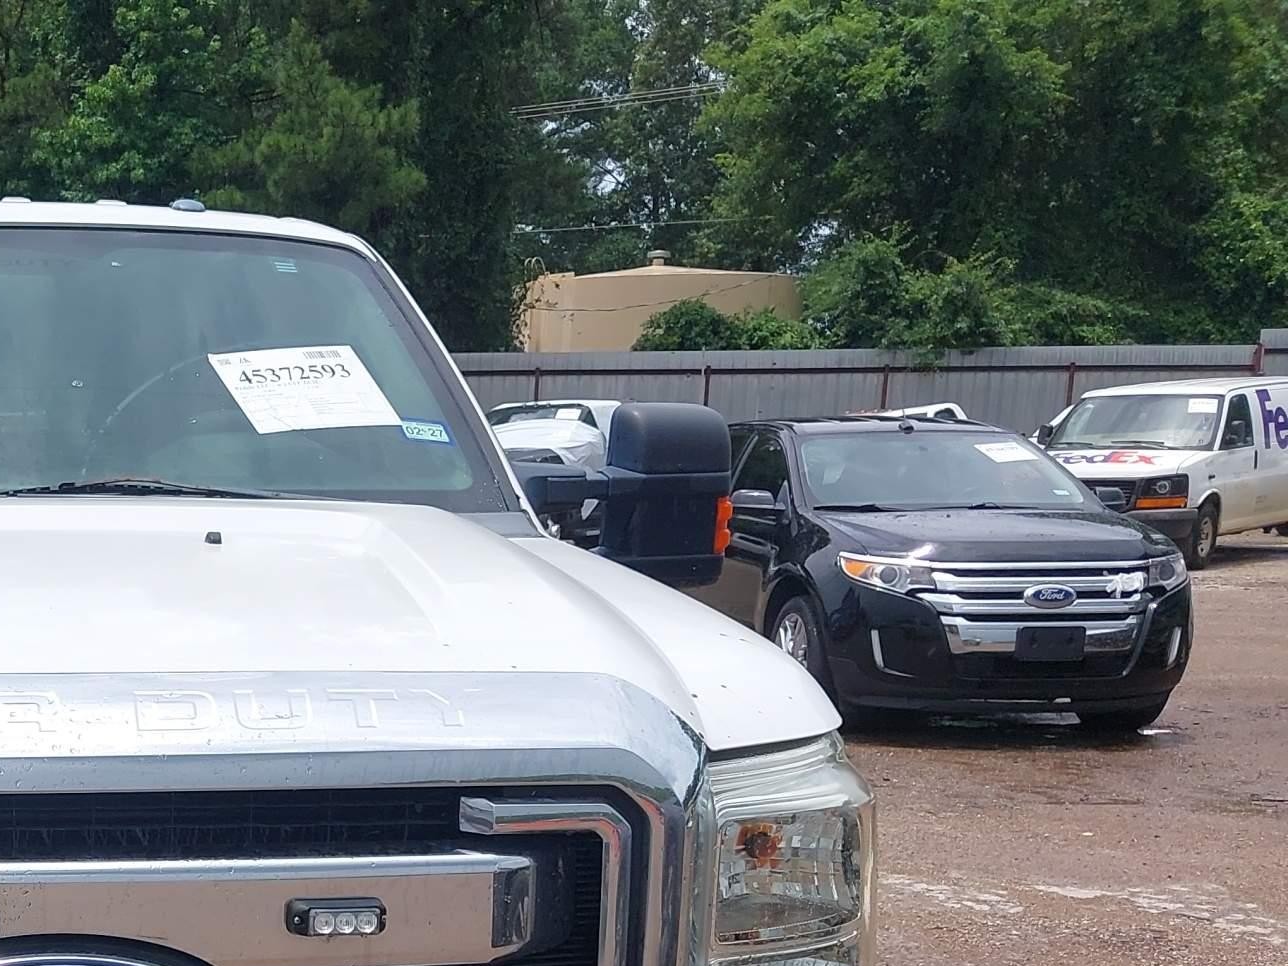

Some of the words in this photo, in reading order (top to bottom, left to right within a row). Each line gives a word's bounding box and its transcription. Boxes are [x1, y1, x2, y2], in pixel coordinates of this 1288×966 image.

[238, 363, 352, 385] 45372593
[1052, 450, 1164, 466] FedEx
[133, 687, 484, 732] DUTY
